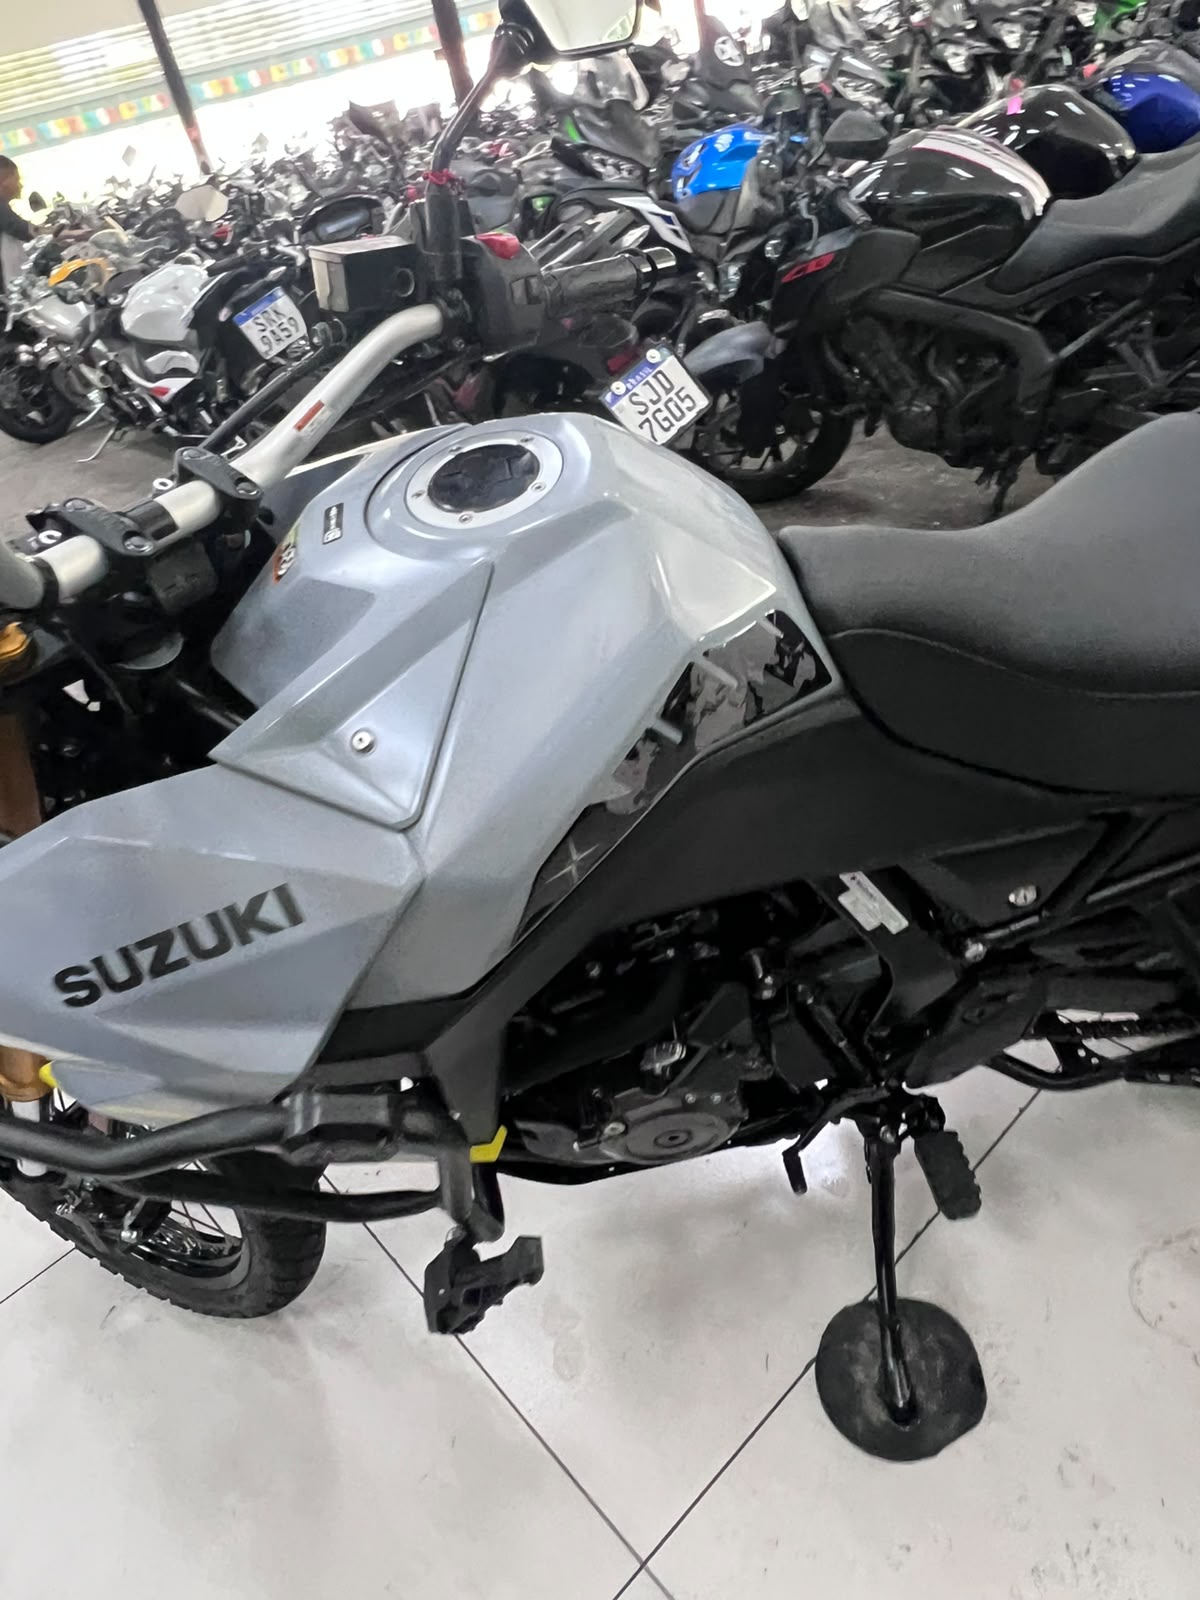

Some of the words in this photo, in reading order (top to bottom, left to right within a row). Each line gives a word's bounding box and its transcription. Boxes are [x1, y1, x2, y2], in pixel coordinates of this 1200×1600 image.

[628, 368, 675, 416] SJD
[638, 386, 697, 443] 7G05
[53, 882, 306, 1008] SUZUKI
